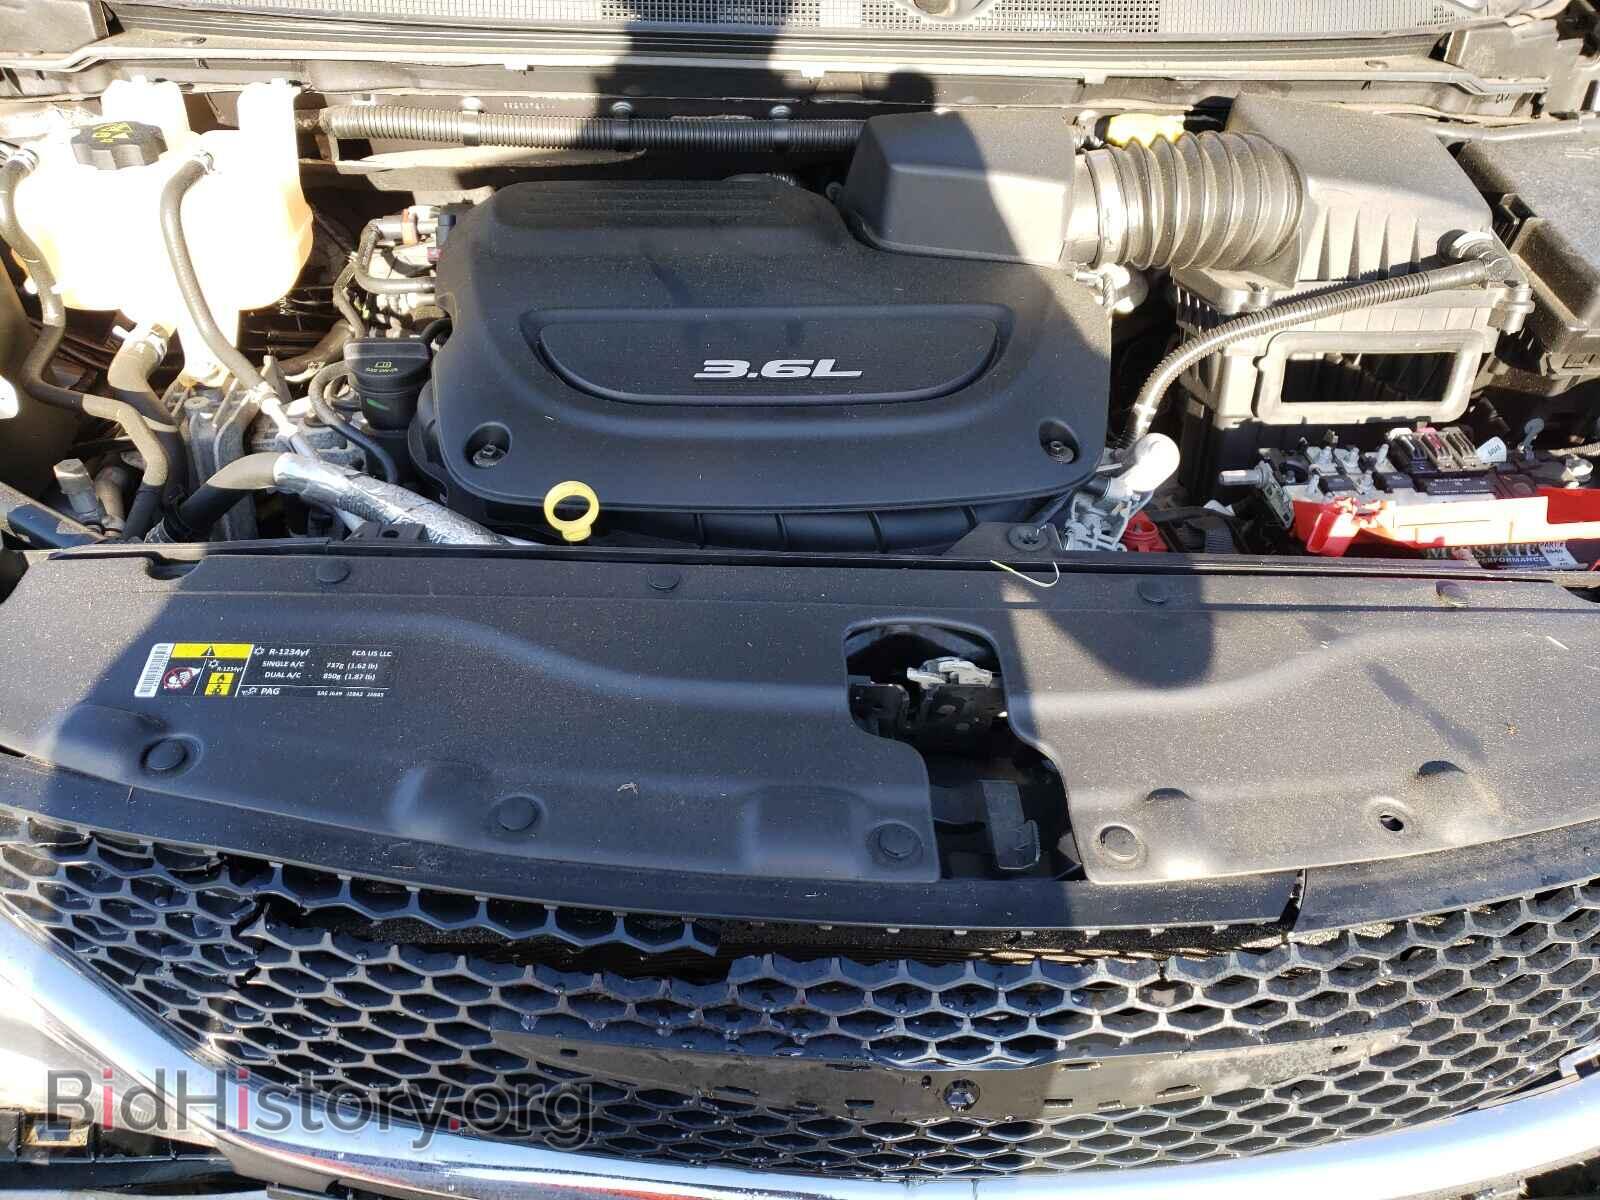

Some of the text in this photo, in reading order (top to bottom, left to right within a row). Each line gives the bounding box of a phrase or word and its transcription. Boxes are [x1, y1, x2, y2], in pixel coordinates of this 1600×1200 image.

[693, 359, 863, 378] 3.6L
[269, 648, 310, 657] R-1234yf
[261, 688, 280, 696] PAG
